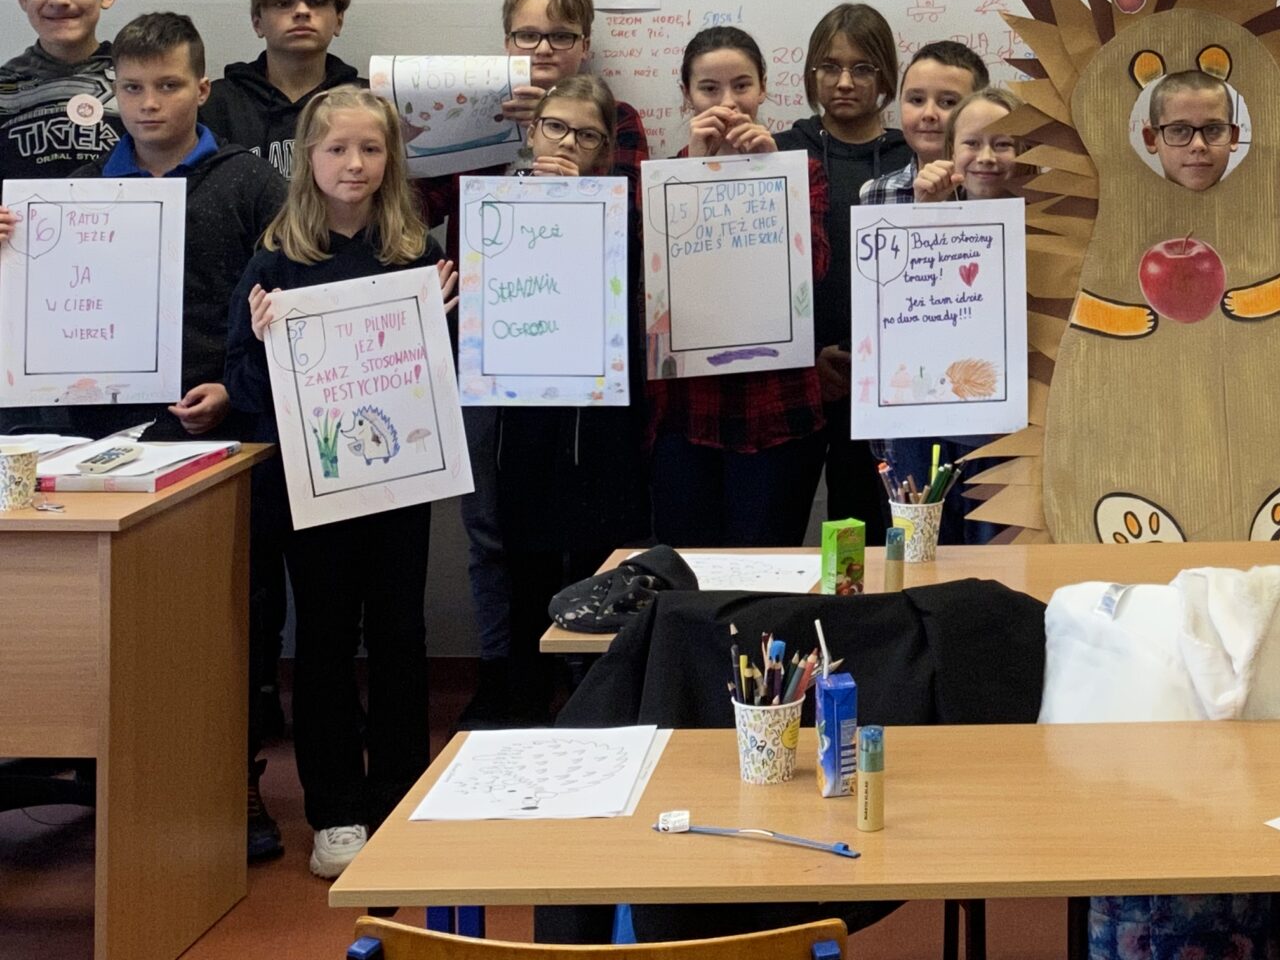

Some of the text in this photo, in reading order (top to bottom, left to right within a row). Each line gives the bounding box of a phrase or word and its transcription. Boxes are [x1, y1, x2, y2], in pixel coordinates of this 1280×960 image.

[8, 116, 121, 157] TIGER
[757, 179, 785, 196] DOM
[66, 211, 110, 227] RATUJ
[703, 204, 732, 222] DLA
[695, 224, 714, 240] ON
[752, 215, 778, 231] CHCE
[910, 229, 994, 251] Bądź ostrożny
[909, 255, 936, 270] przy
[69, 265, 92, 289] JA
[903, 267, 944, 287] trawy!
[46, 298, 104, 312] W CIEBIE
[930, 294, 954, 305] tam
[335, 322, 353, 338] TU
[882, 317, 896, 329] po
[304, 365, 350, 387] ZAKAZ
